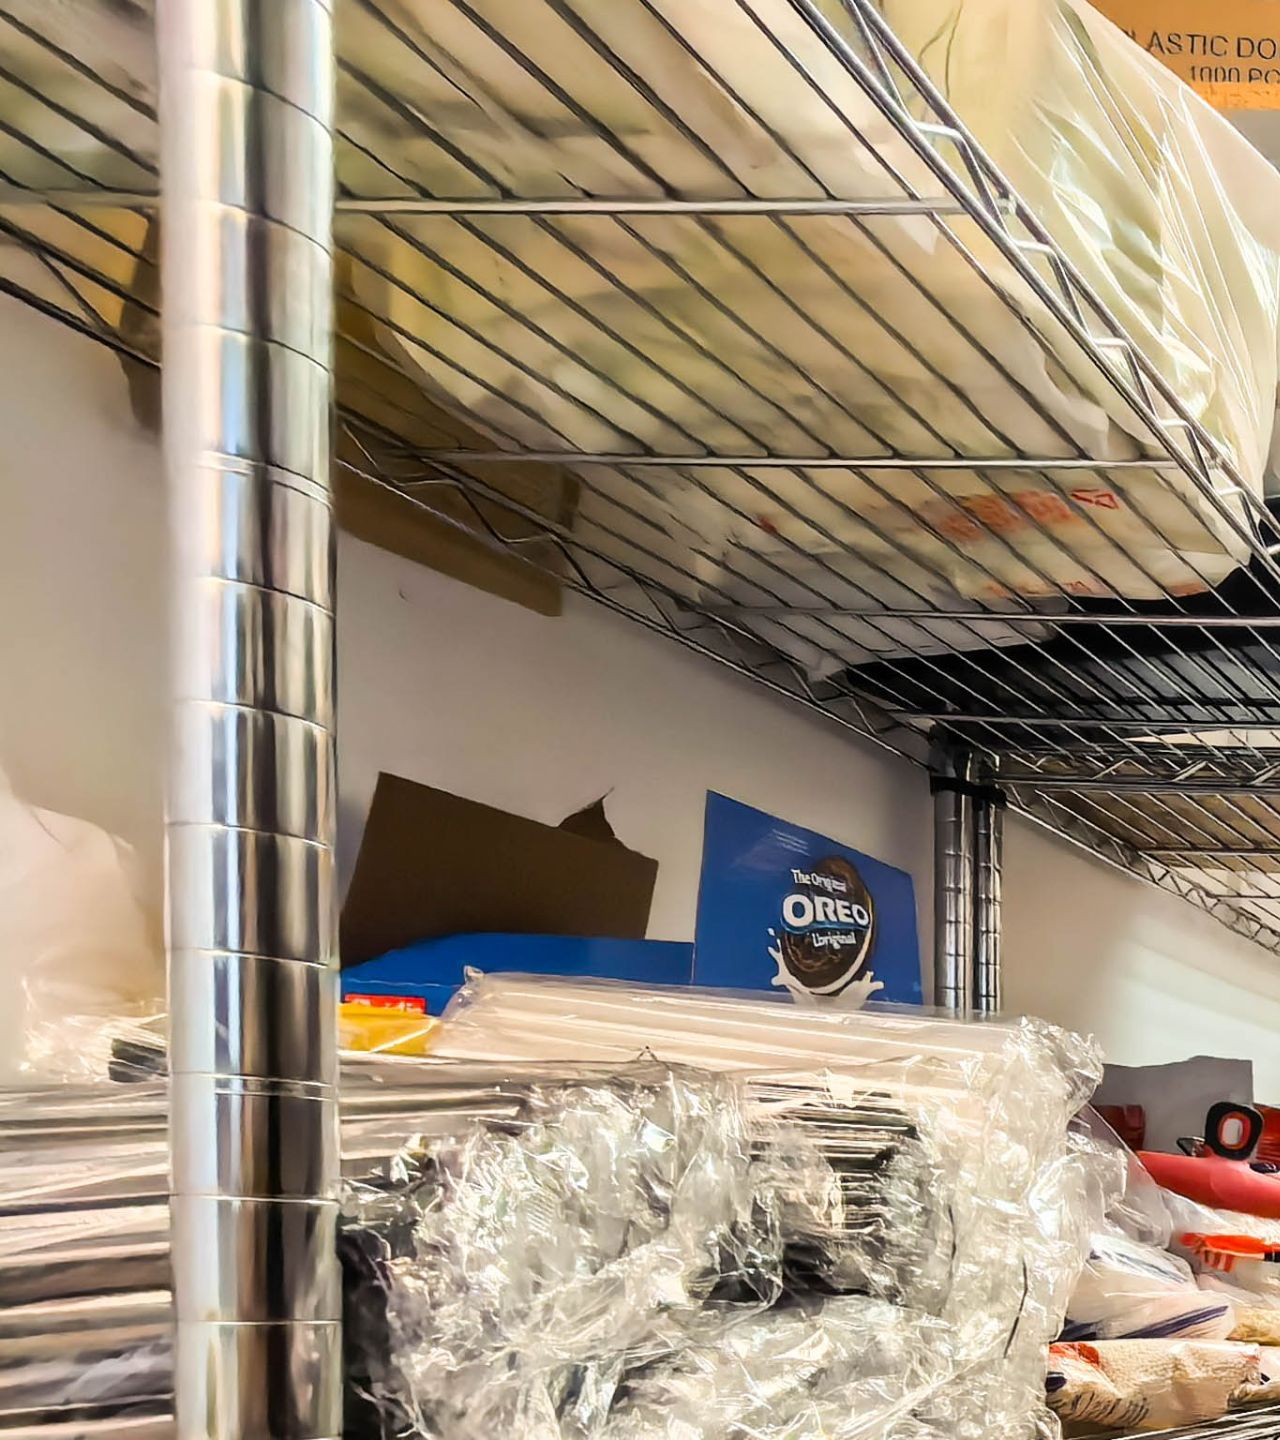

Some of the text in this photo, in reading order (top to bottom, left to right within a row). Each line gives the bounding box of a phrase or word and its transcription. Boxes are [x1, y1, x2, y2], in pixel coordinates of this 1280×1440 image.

[1121, 28, 1229, 58] ASTIC
[790, 868, 812, 885] The
[782, 893, 869, 927] OREO
